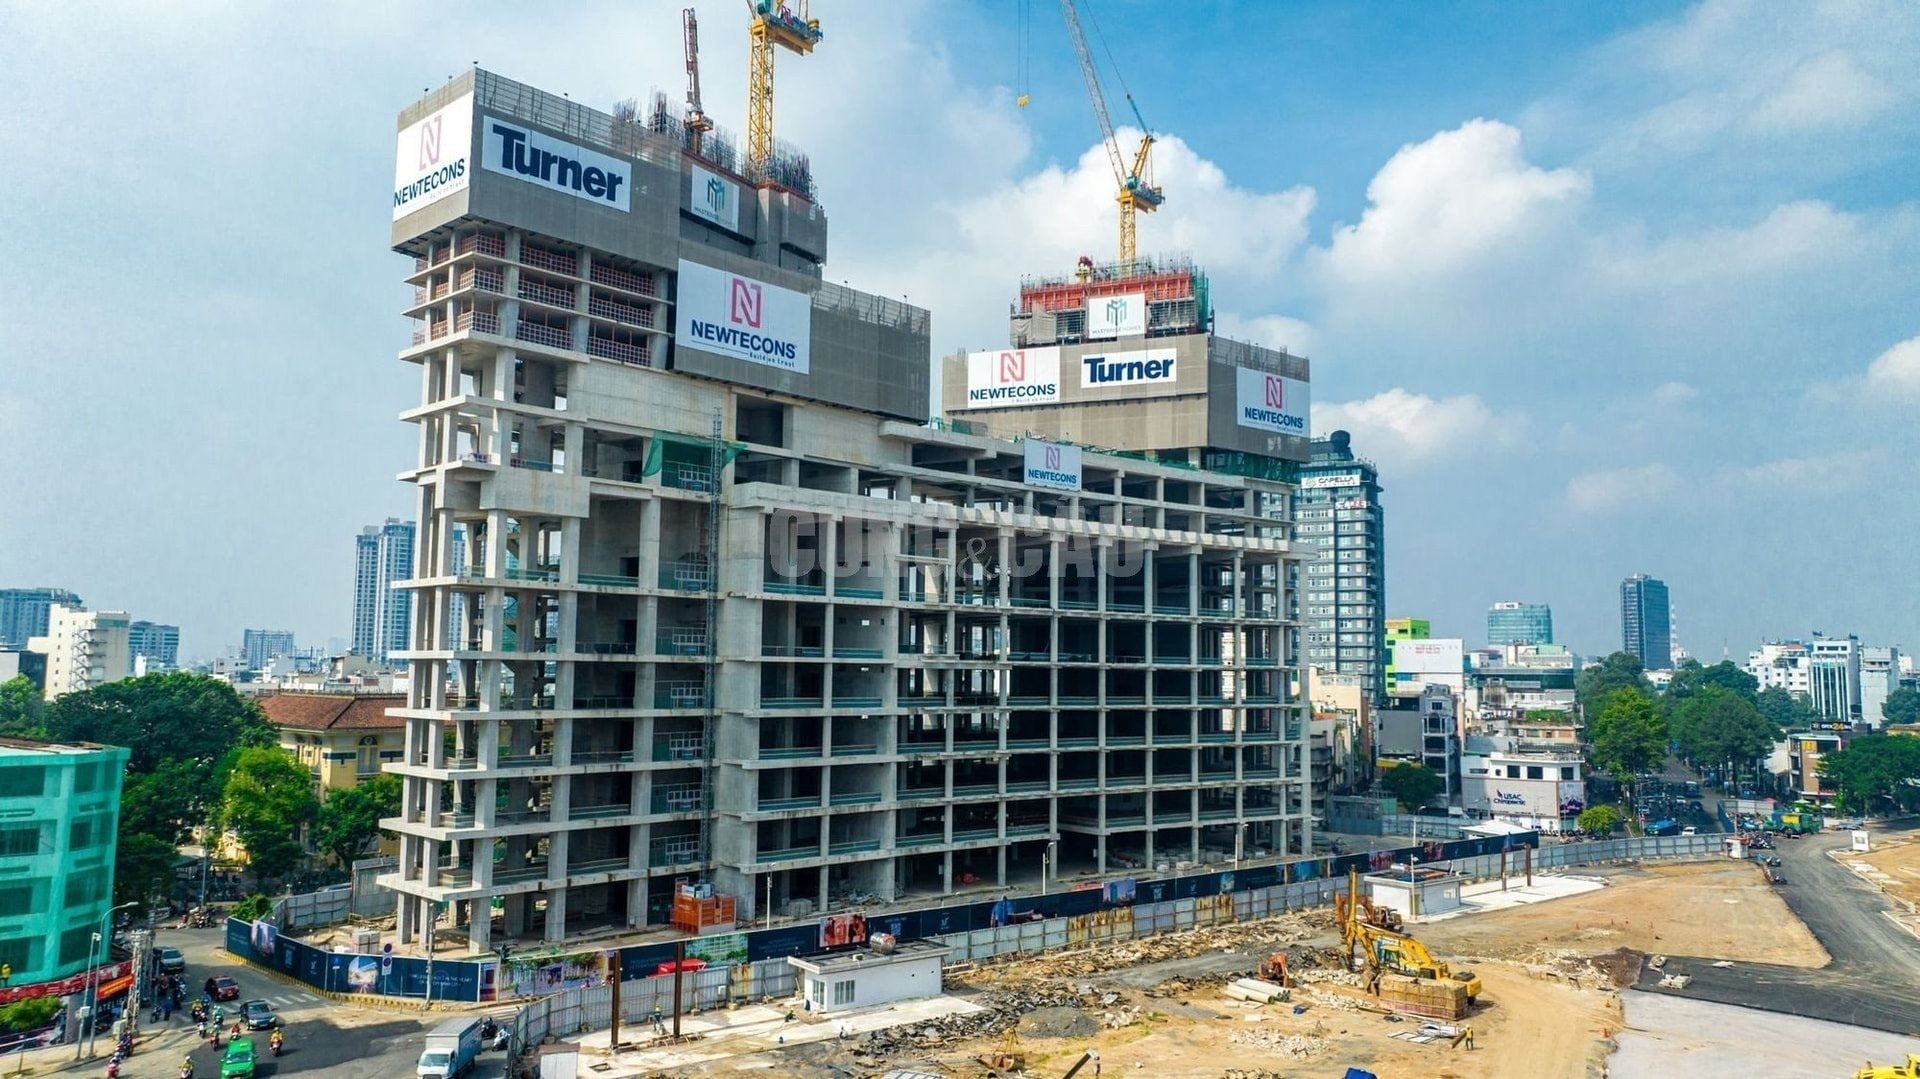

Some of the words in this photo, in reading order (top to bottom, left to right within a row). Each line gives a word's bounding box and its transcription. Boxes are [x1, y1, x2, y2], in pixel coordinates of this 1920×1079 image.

[492, 123, 624, 202] Turner
[393, 158, 466, 208] NEWTECONS
[691, 319, 796, 359] NEWTECONS
[1083, 357, 1174, 384] Turner
[970, 383, 1056, 401] NEWTECONS
[1245, 407, 1304, 429] NEWTECONS
[1028, 469, 1077, 484] NEWTECONS
[1318, 476, 1355, 484] CAPELLA
